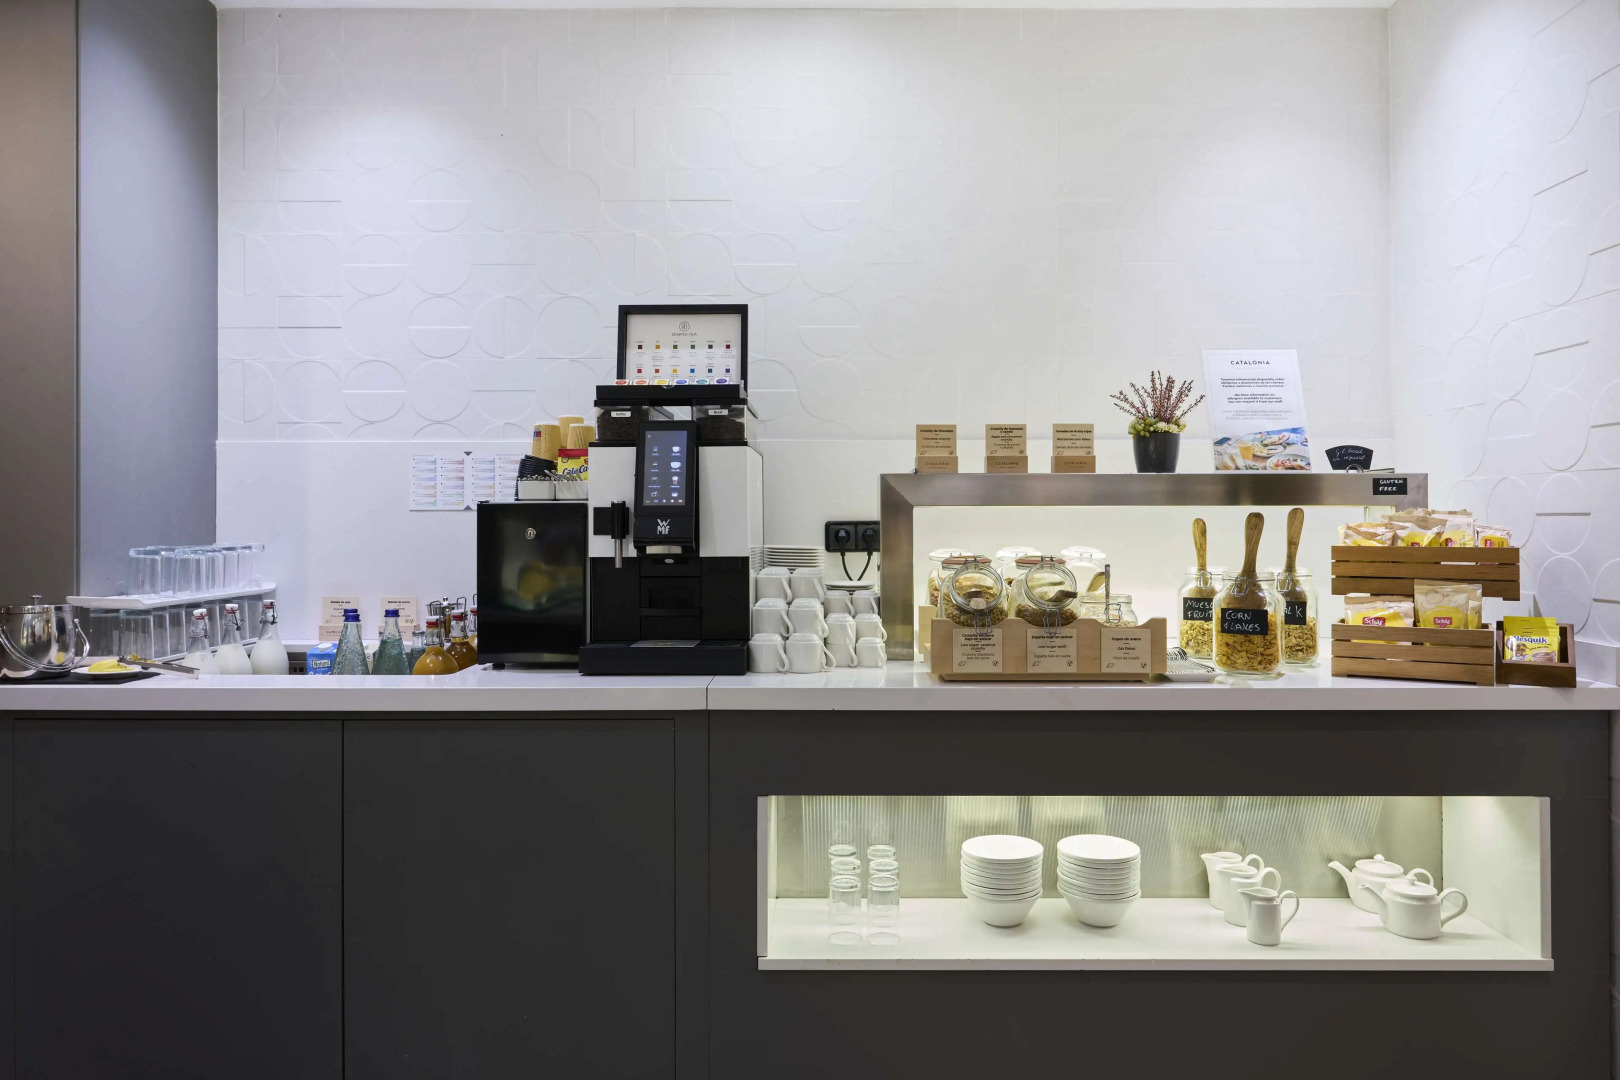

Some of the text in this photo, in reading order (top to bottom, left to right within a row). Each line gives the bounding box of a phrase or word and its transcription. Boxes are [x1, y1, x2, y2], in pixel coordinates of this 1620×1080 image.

[1225, 610, 1252, 620] CORN
[1295, 605, 1303, 618] K
[1223, 622, 1261, 632] FLAKES
[1513, 635, 1547, 644] Nesquik
